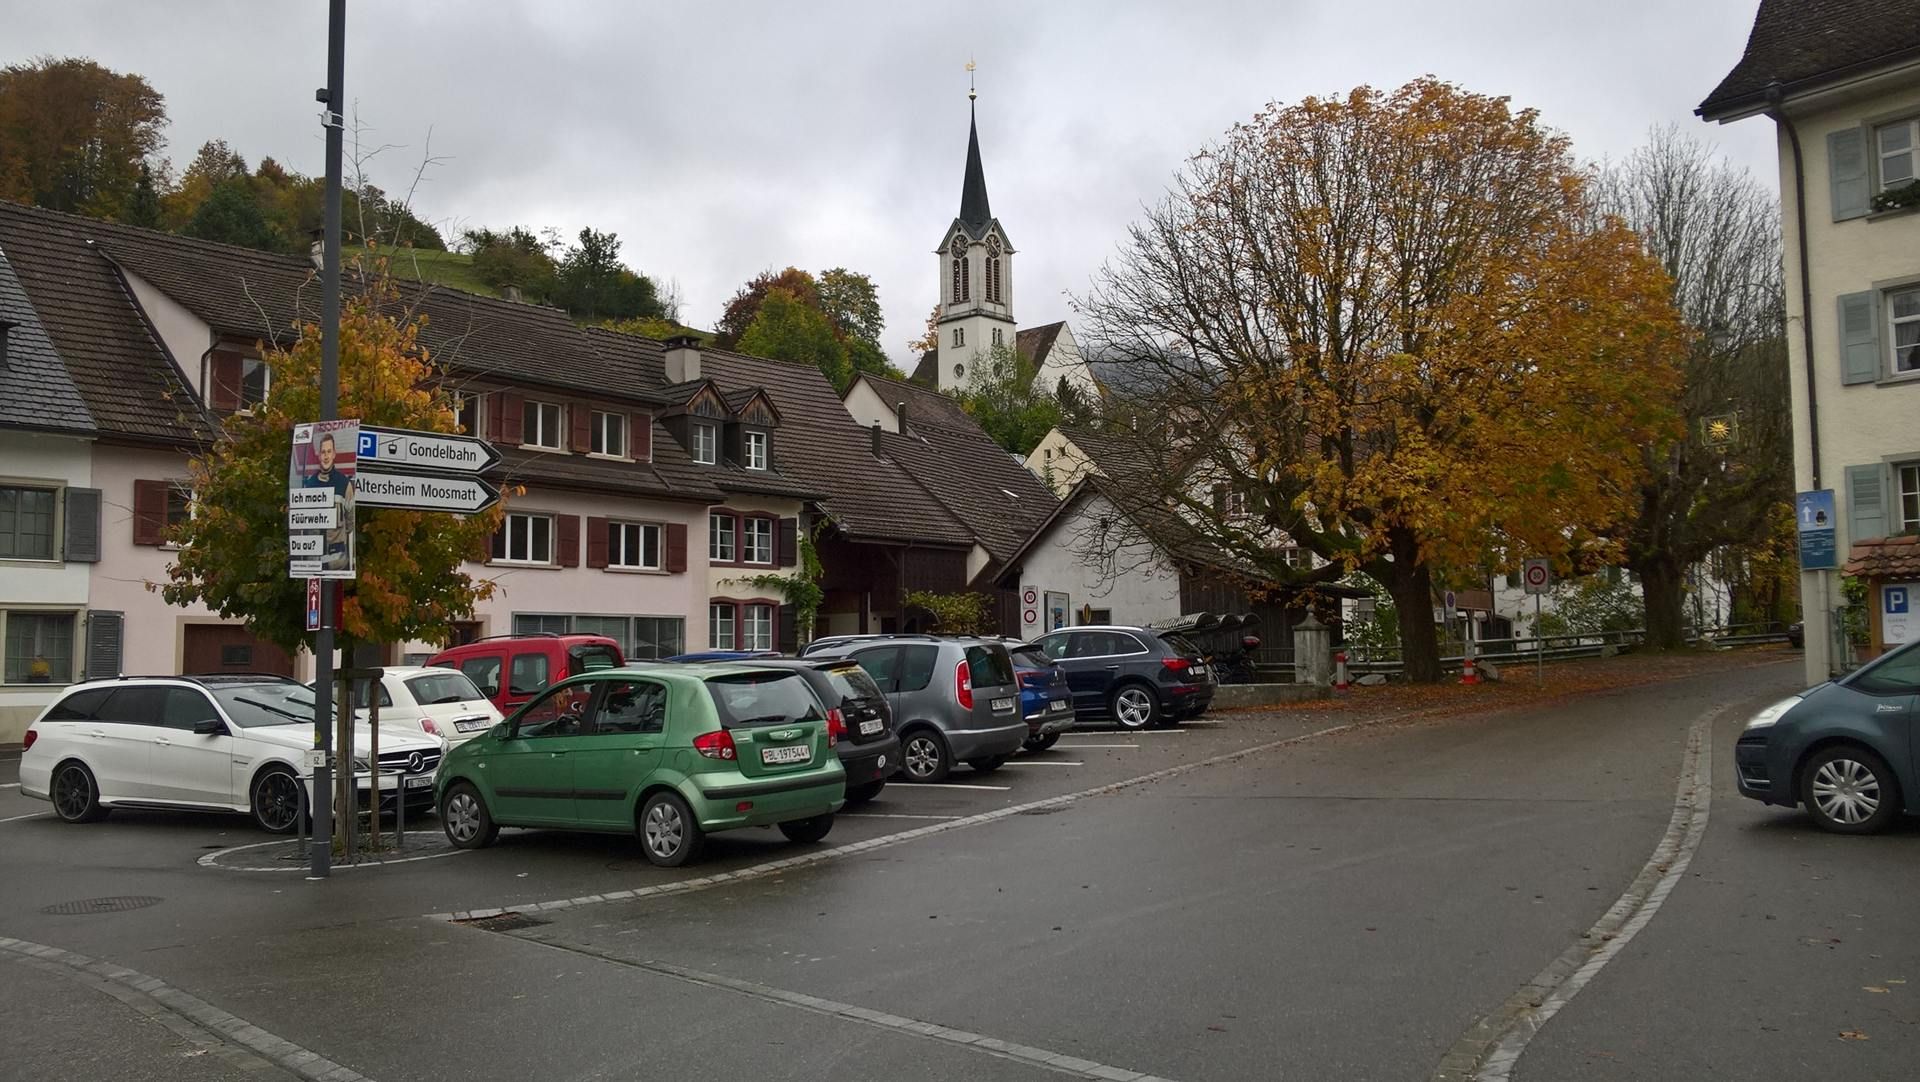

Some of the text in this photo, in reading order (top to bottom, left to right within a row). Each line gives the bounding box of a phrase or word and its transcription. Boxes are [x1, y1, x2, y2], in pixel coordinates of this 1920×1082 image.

[359, 436, 477, 462] P Gondelbahn
[291, 493, 303, 504] Ich
[355, 478, 477, 501] Altersheim Moosmatt
[291, 540, 302, 550] Du
[1890, 591, 1903, 611] P
